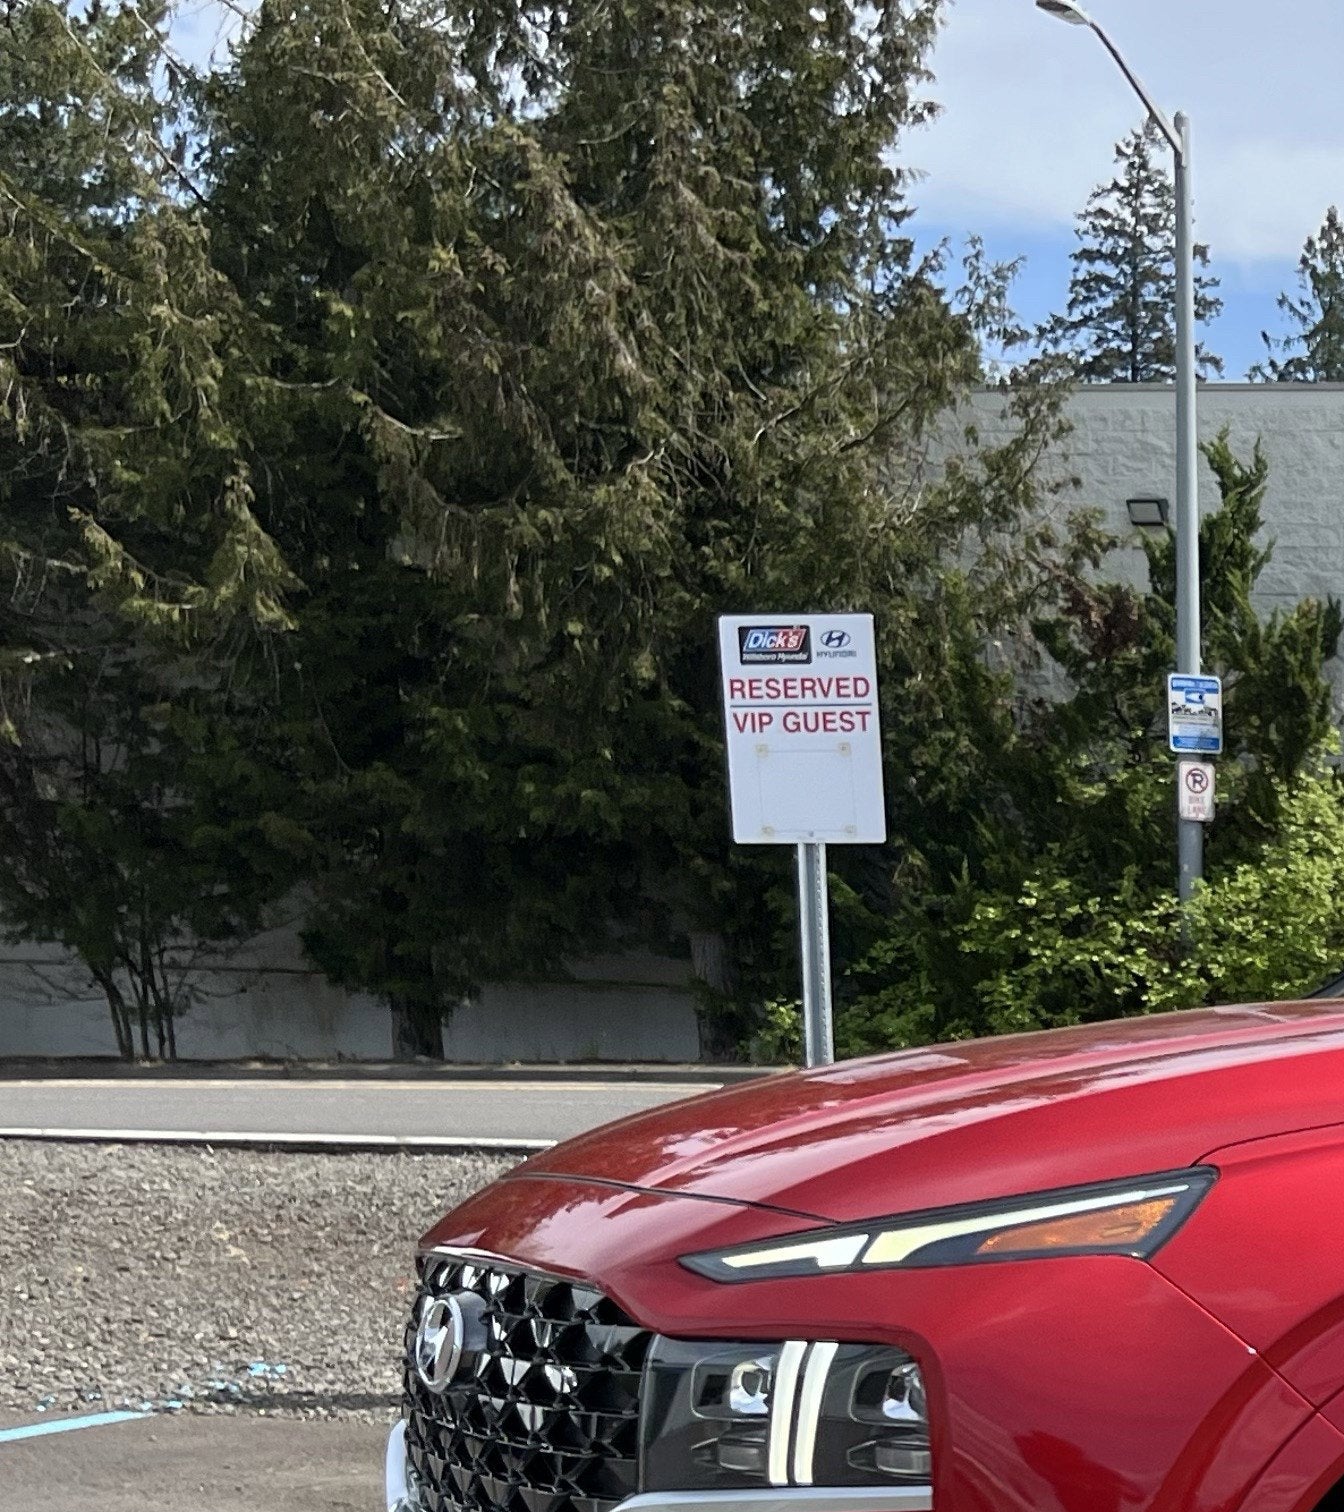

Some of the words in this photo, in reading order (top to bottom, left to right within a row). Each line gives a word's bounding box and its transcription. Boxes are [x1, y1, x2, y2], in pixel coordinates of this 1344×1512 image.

[730, 676, 871, 700] RESERVED
[732, 712, 774, 734] VIP
[782, 710, 872, 733] GUEST
